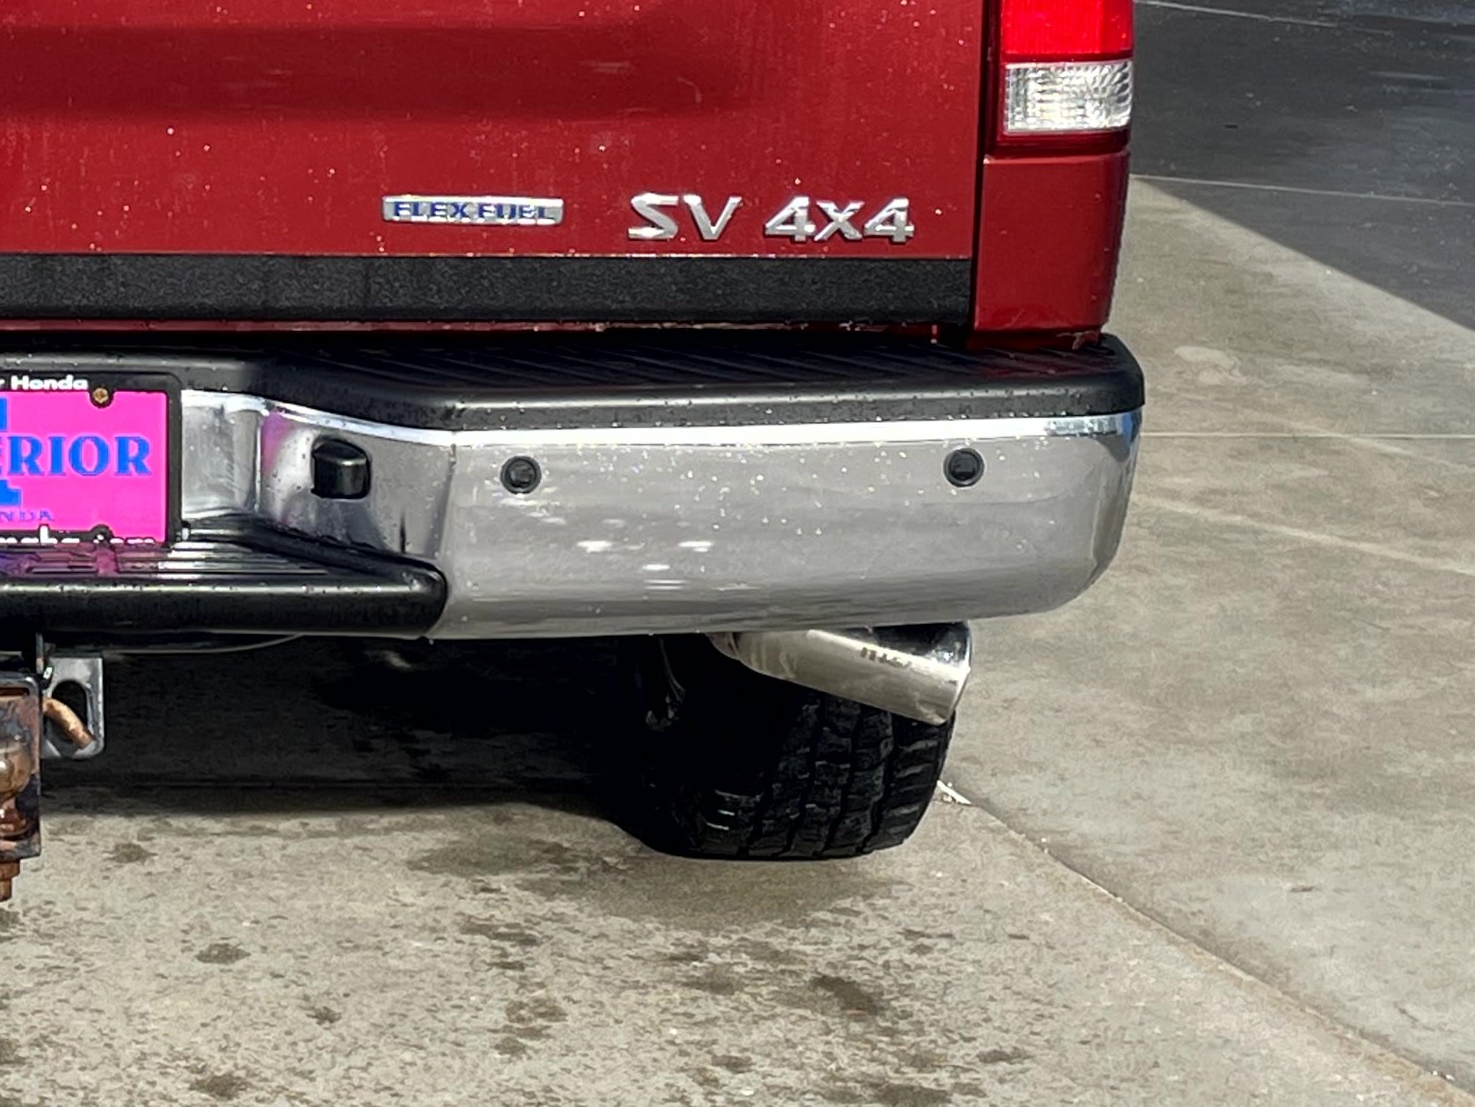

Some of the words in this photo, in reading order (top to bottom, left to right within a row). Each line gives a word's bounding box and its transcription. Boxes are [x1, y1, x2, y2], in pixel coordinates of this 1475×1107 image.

[393, 201, 471, 221] FLEX
[477, 203, 556, 225] FUEL
[628, 192, 743, 240] SV
[10, 374, 89, 391] Honda
